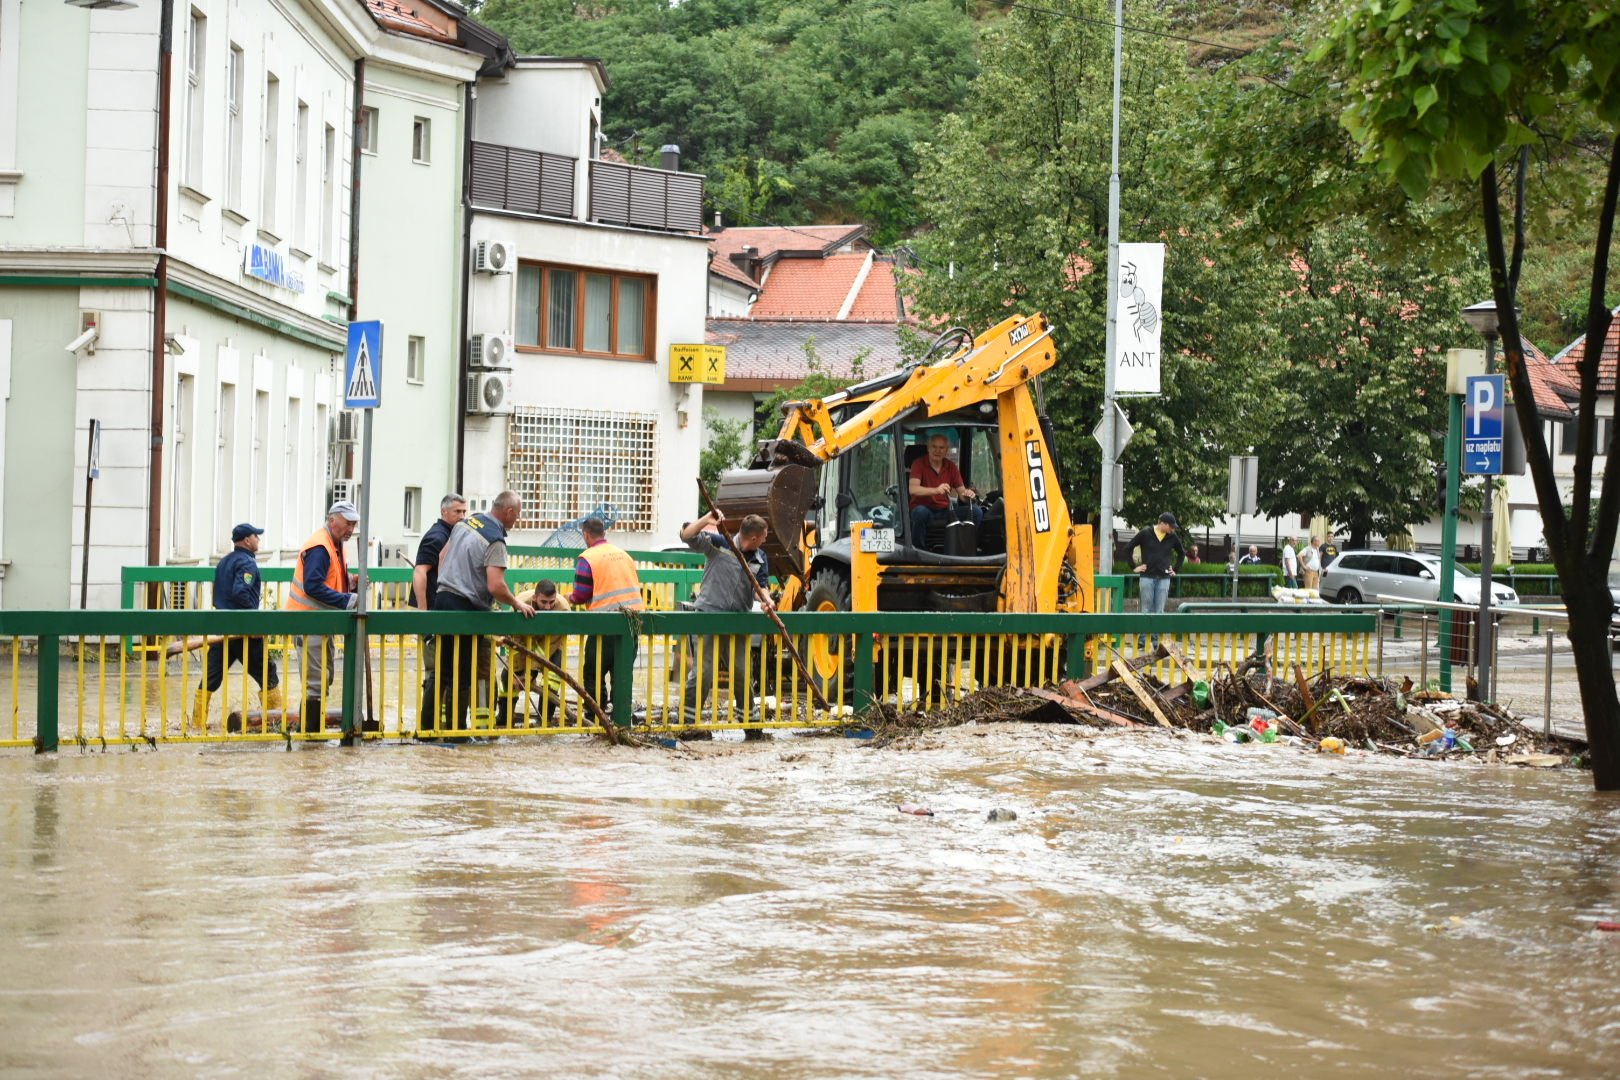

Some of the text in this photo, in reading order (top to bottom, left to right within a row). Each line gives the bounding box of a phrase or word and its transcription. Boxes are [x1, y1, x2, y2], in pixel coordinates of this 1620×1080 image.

[264, 248, 284, 287] BANKA
[1120, 351, 1155, 367] ANT
[1473, 381, 1495, 435] P
[1466, 440, 1500, 455] uz naplatu
[1026, 441, 1049, 532] JCB
